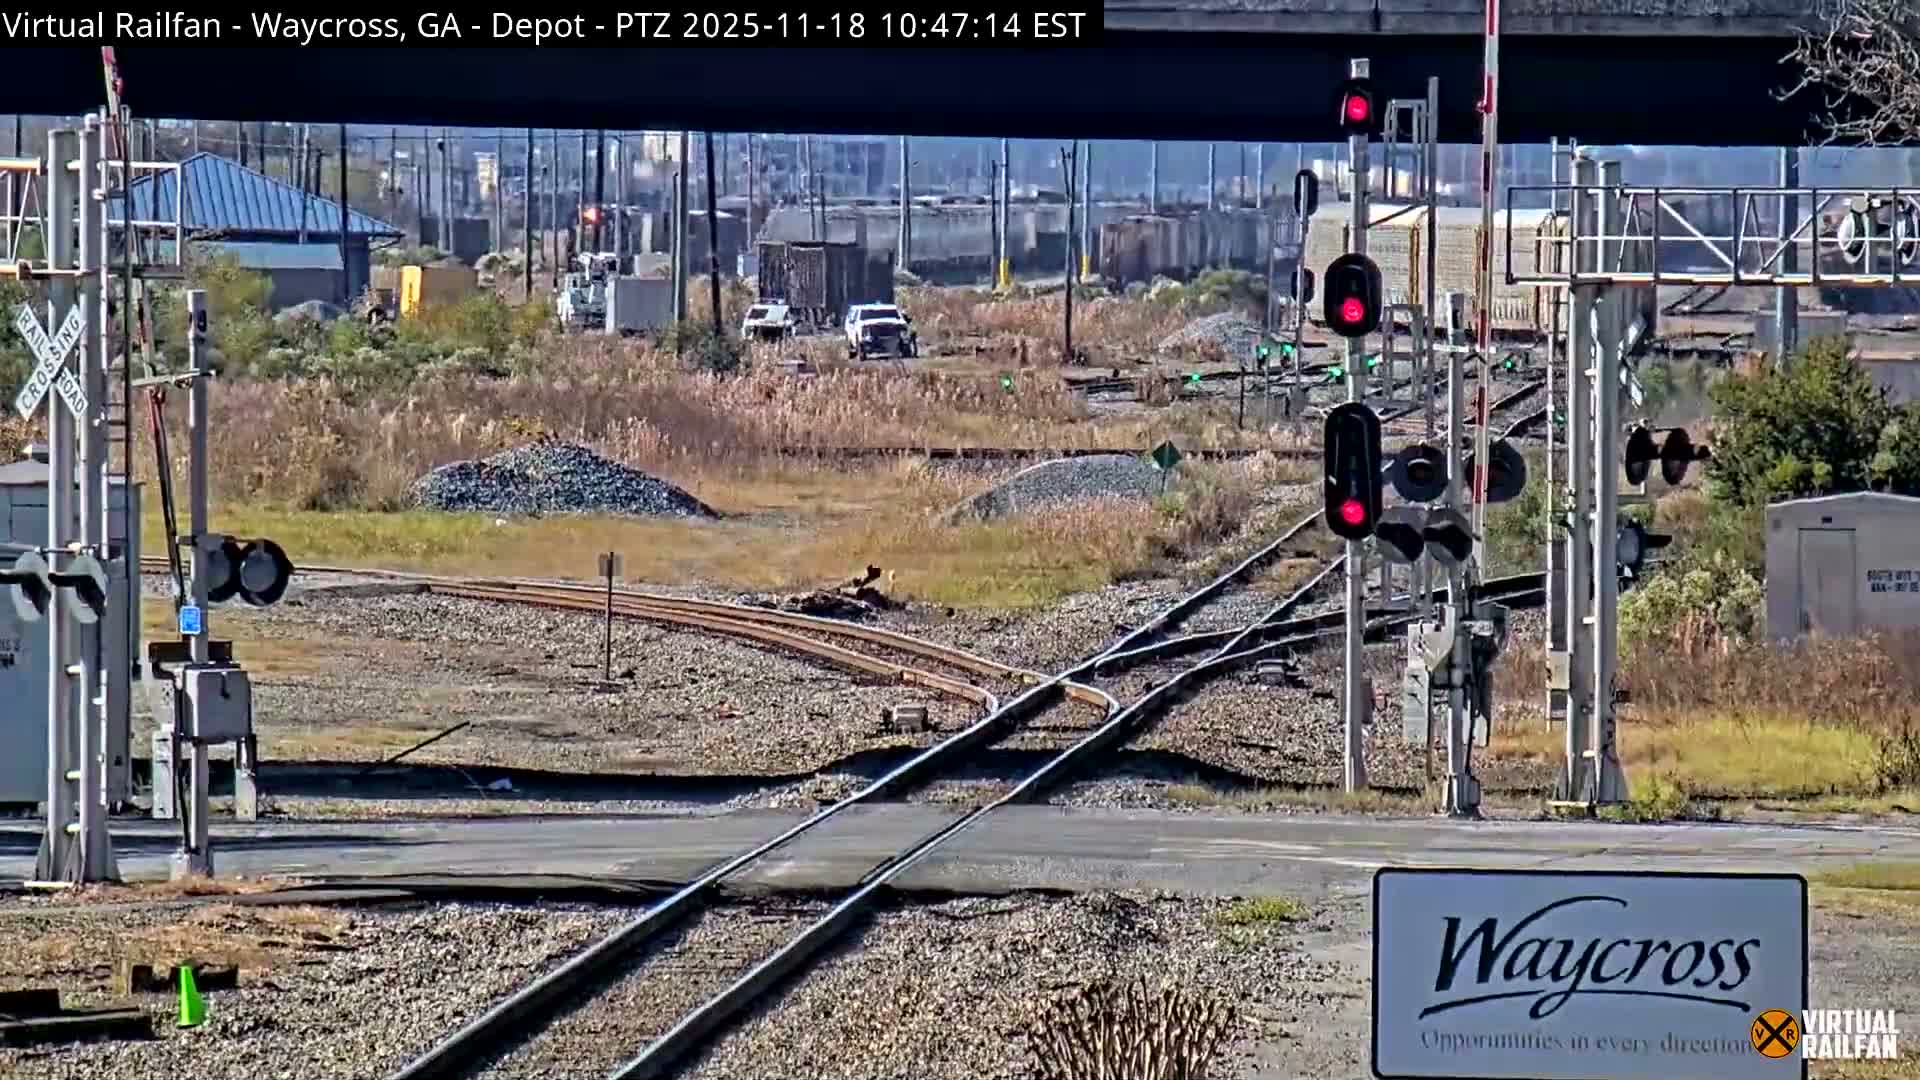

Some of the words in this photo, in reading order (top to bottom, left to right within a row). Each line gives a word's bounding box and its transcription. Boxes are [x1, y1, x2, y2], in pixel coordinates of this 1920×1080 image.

[21, 314, 80, 409] CROSSING
[1434, 896, 1761, 1019] Waycross
[1420, 1029, 1563, 1053] Opportunities
[1571, 1032, 1590, 1050] in
[1596, 1036, 1650, 1056] every
[1659, 1031, 1752, 1055] direction
